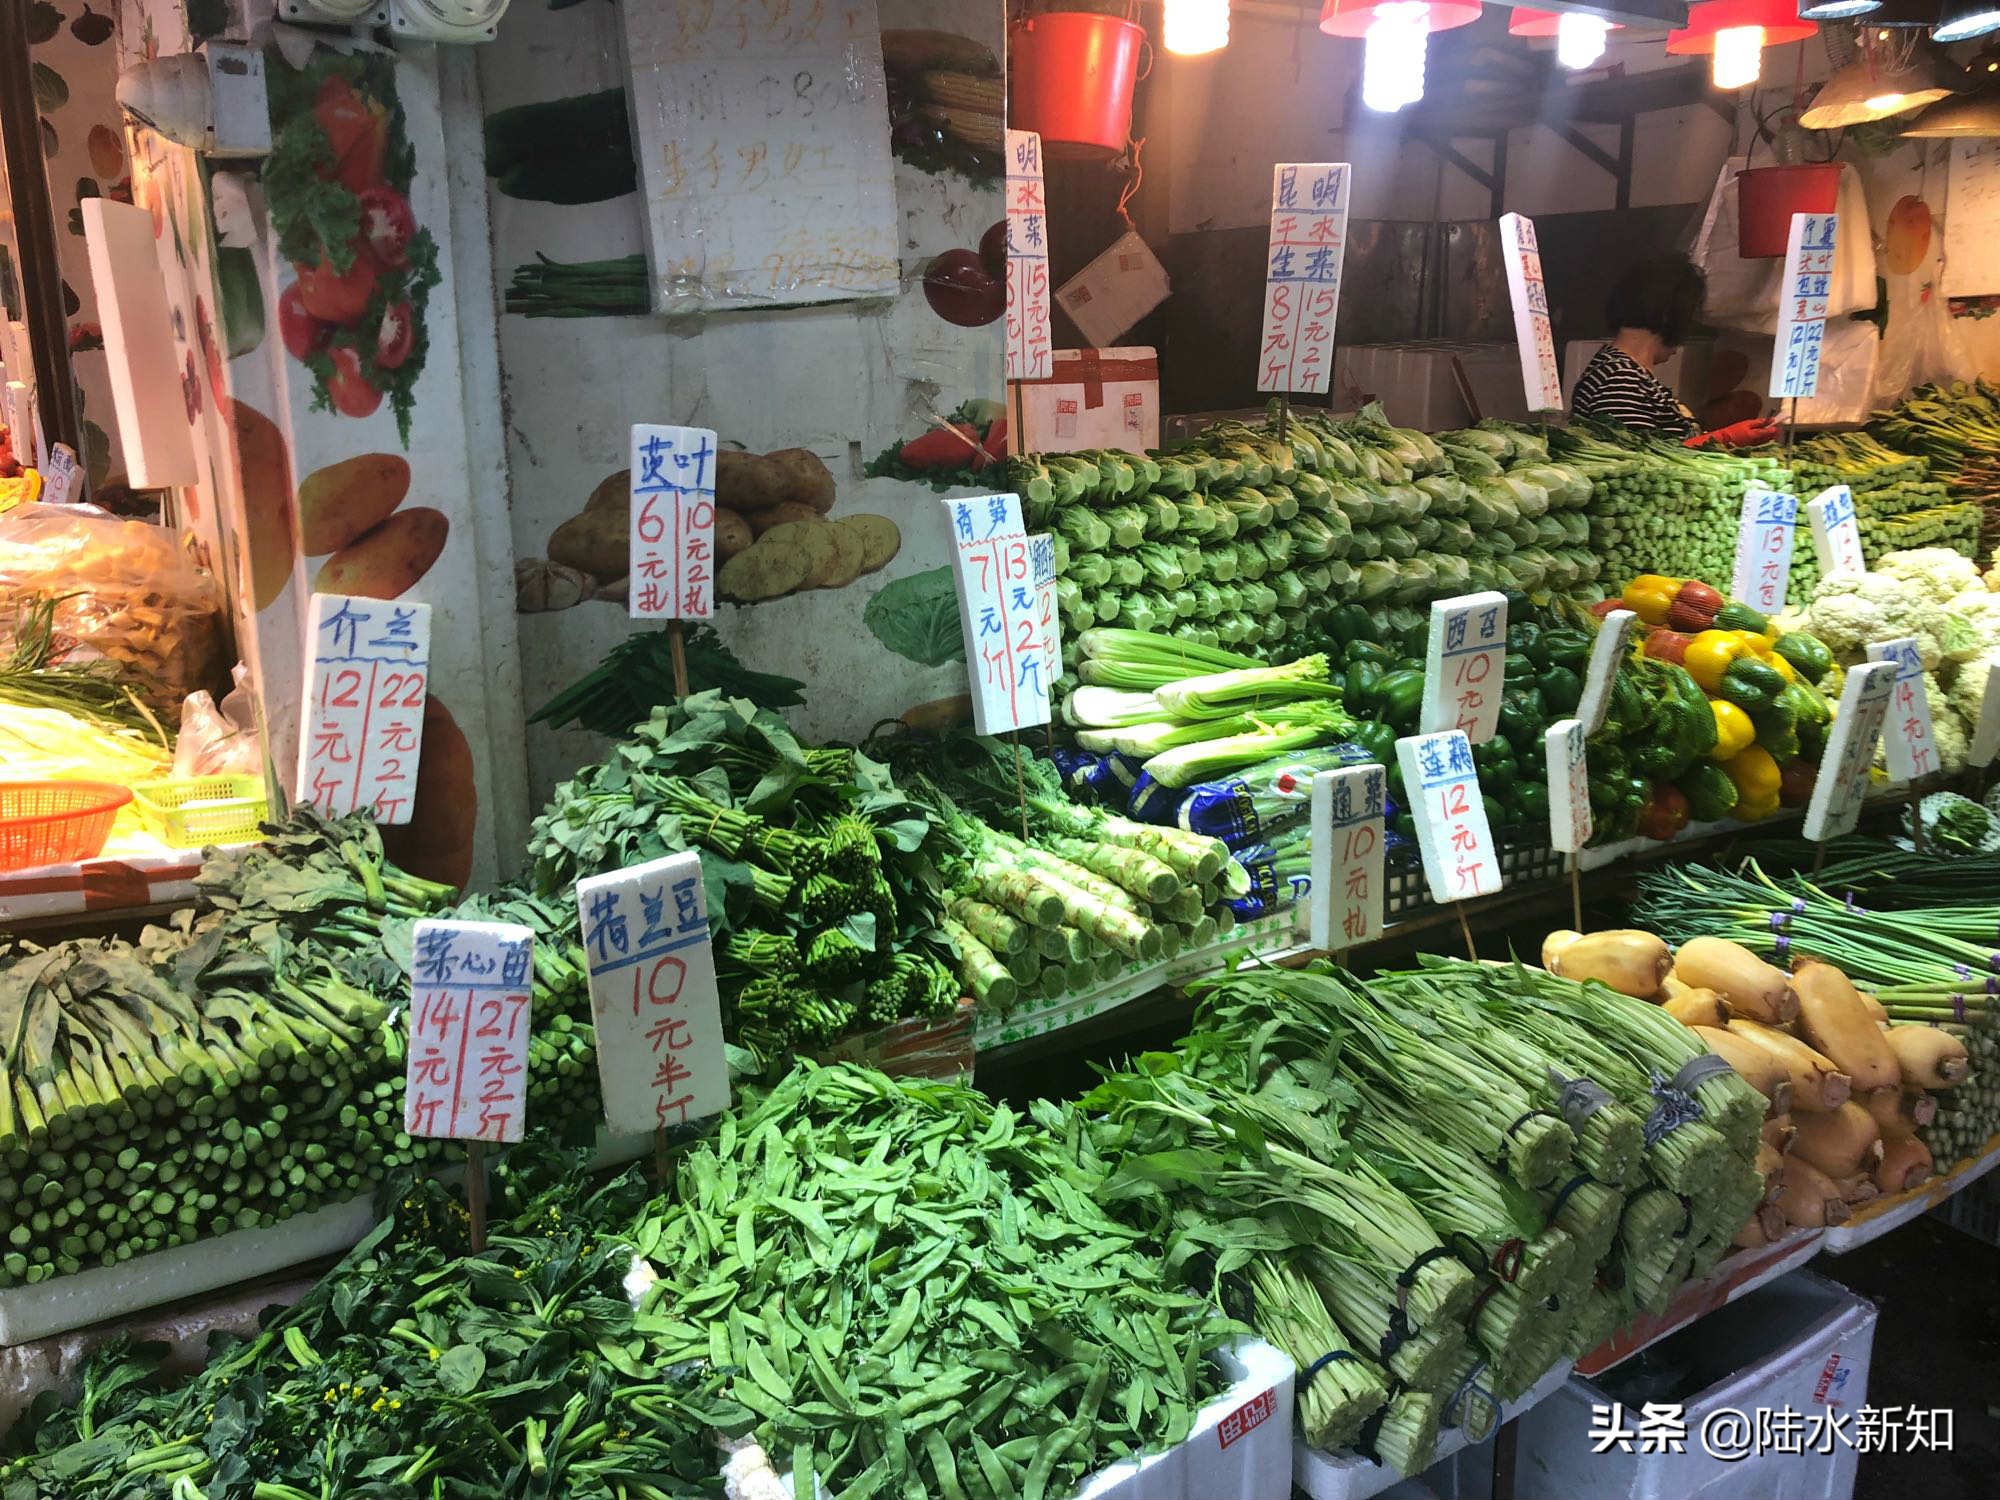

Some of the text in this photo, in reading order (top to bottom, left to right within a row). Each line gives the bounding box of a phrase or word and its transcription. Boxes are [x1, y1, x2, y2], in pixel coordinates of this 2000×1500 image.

[1016, 134, 1037, 174] 明
[1016, 180, 1042, 209] 水
[1280, 166, 1342, 208] 昆明
[1271, 246, 1335, 278] 生菜
[318, 599, 418, 657] 介兰
[586, 877, 709, 962] 荷兰豆
[416, 928, 532, 986] 菜心苗
